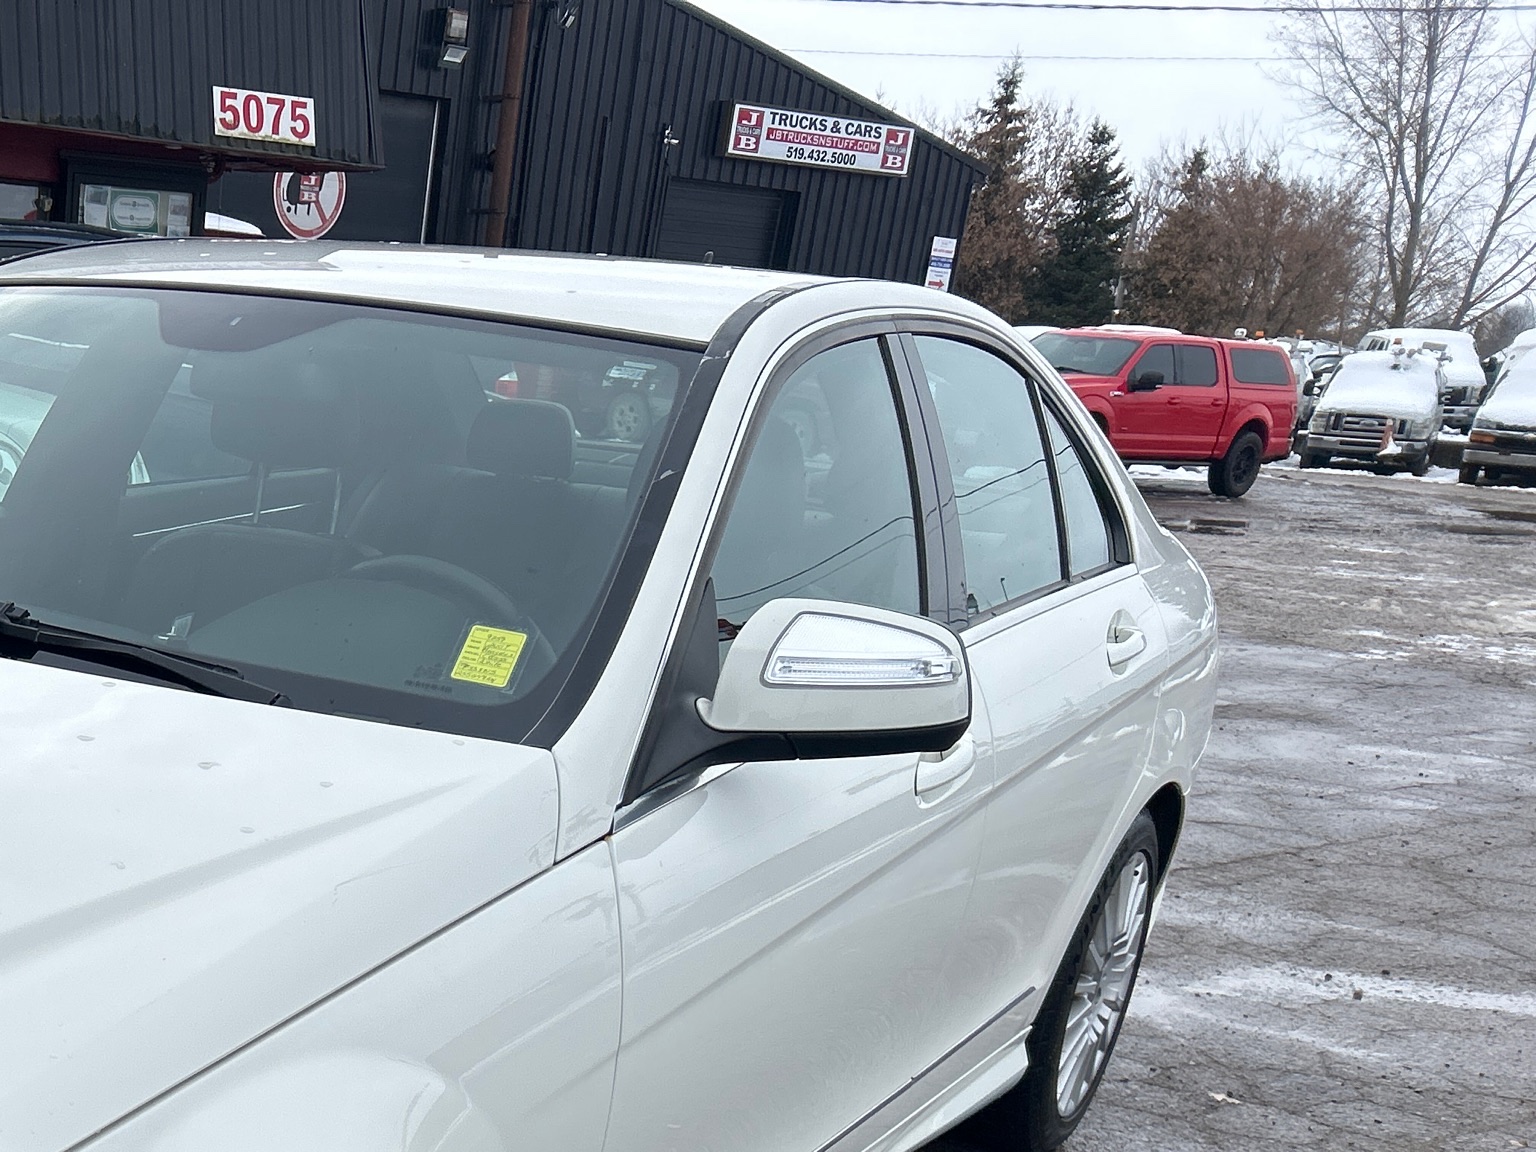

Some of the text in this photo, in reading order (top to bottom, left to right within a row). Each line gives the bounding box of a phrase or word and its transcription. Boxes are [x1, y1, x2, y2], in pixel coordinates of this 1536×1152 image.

[219, 90, 310, 139] 5075
[741, 111, 760, 126] J
[769, 111, 882, 139] TRUCKS & CARS
[736, 135, 757, 150] B
[769, 129, 878, 152] JBTRUCKSNSTUFF.COM
[889, 132, 905, 145] J
[785, 146, 857, 166] 519.432.5000
[884, 154, 902, 168] B
